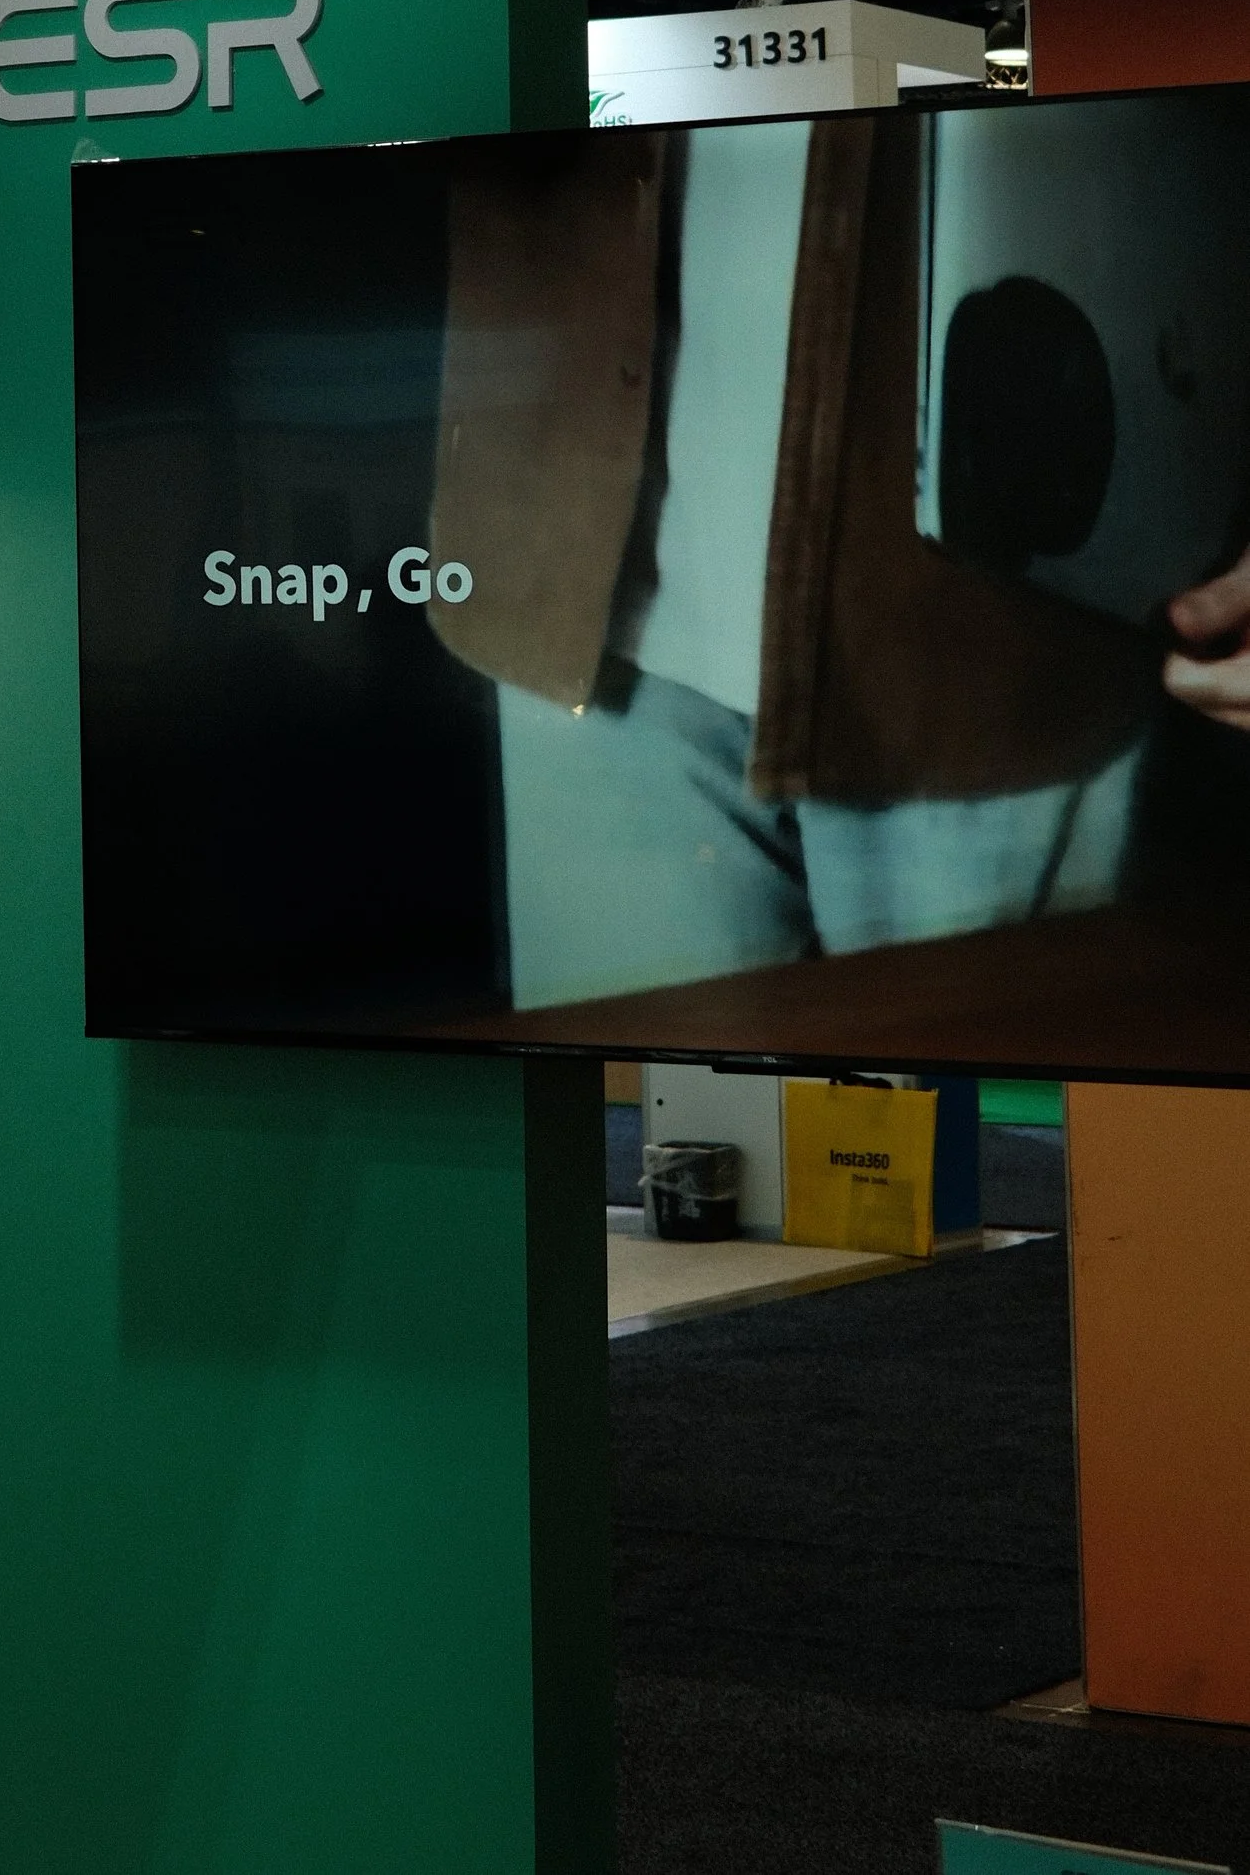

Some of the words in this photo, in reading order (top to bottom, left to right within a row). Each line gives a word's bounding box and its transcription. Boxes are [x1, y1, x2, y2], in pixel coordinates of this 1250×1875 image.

[713, 27, 827, 69] 31331
[203, 550, 373, 621] Snap,
[387, 546, 473, 604] Go
[830, 1149, 890, 1170] Insta360
